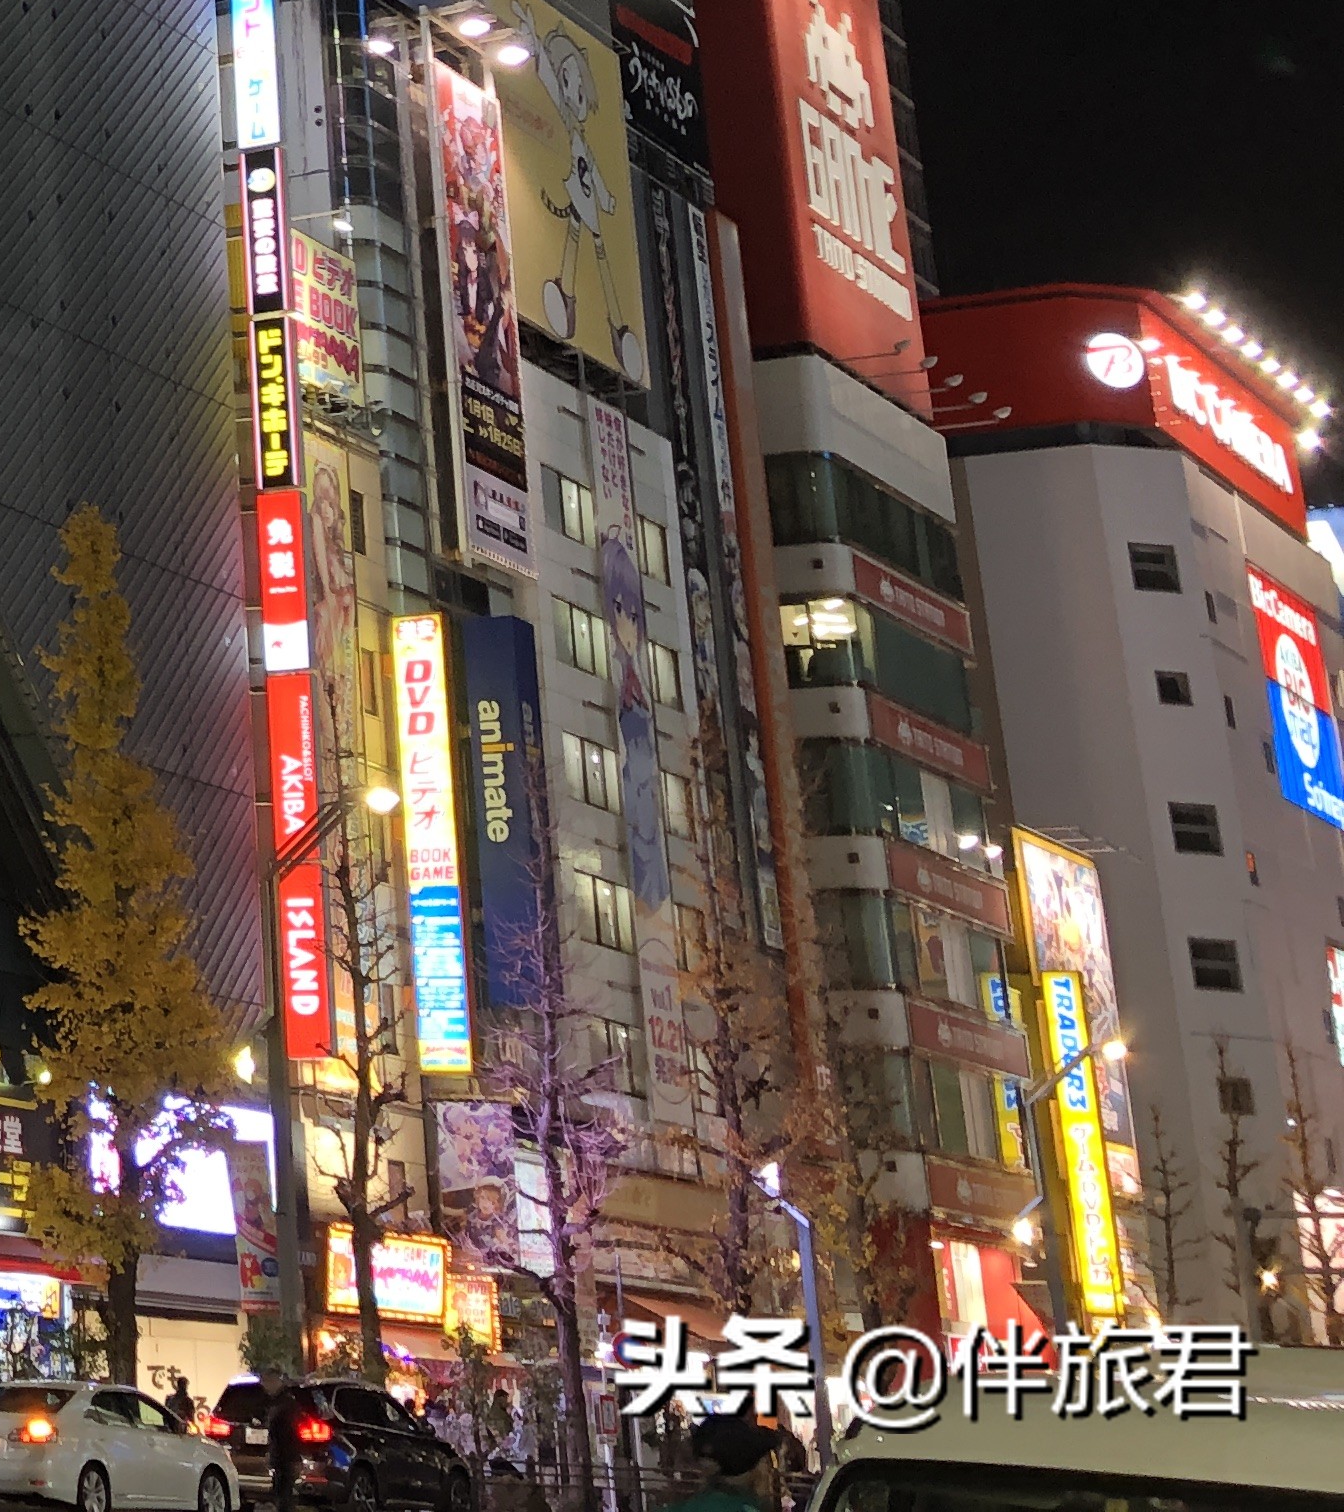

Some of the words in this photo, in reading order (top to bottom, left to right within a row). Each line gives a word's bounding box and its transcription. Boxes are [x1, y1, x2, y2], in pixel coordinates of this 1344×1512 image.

[798, 97, 907, 274] GAME
[309, 285, 359, 339] BOOK
[405, 659, 435, 737] DVD
[279, 754, 307, 836] AKIBA
[409, 750, 441, 830] ビデオ
[476, 698, 516, 845] animate
[409, 848, 452, 864] BOOK
[410, 866, 455, 881] GAME
[285, 896, 320, 1016] ISLAND
